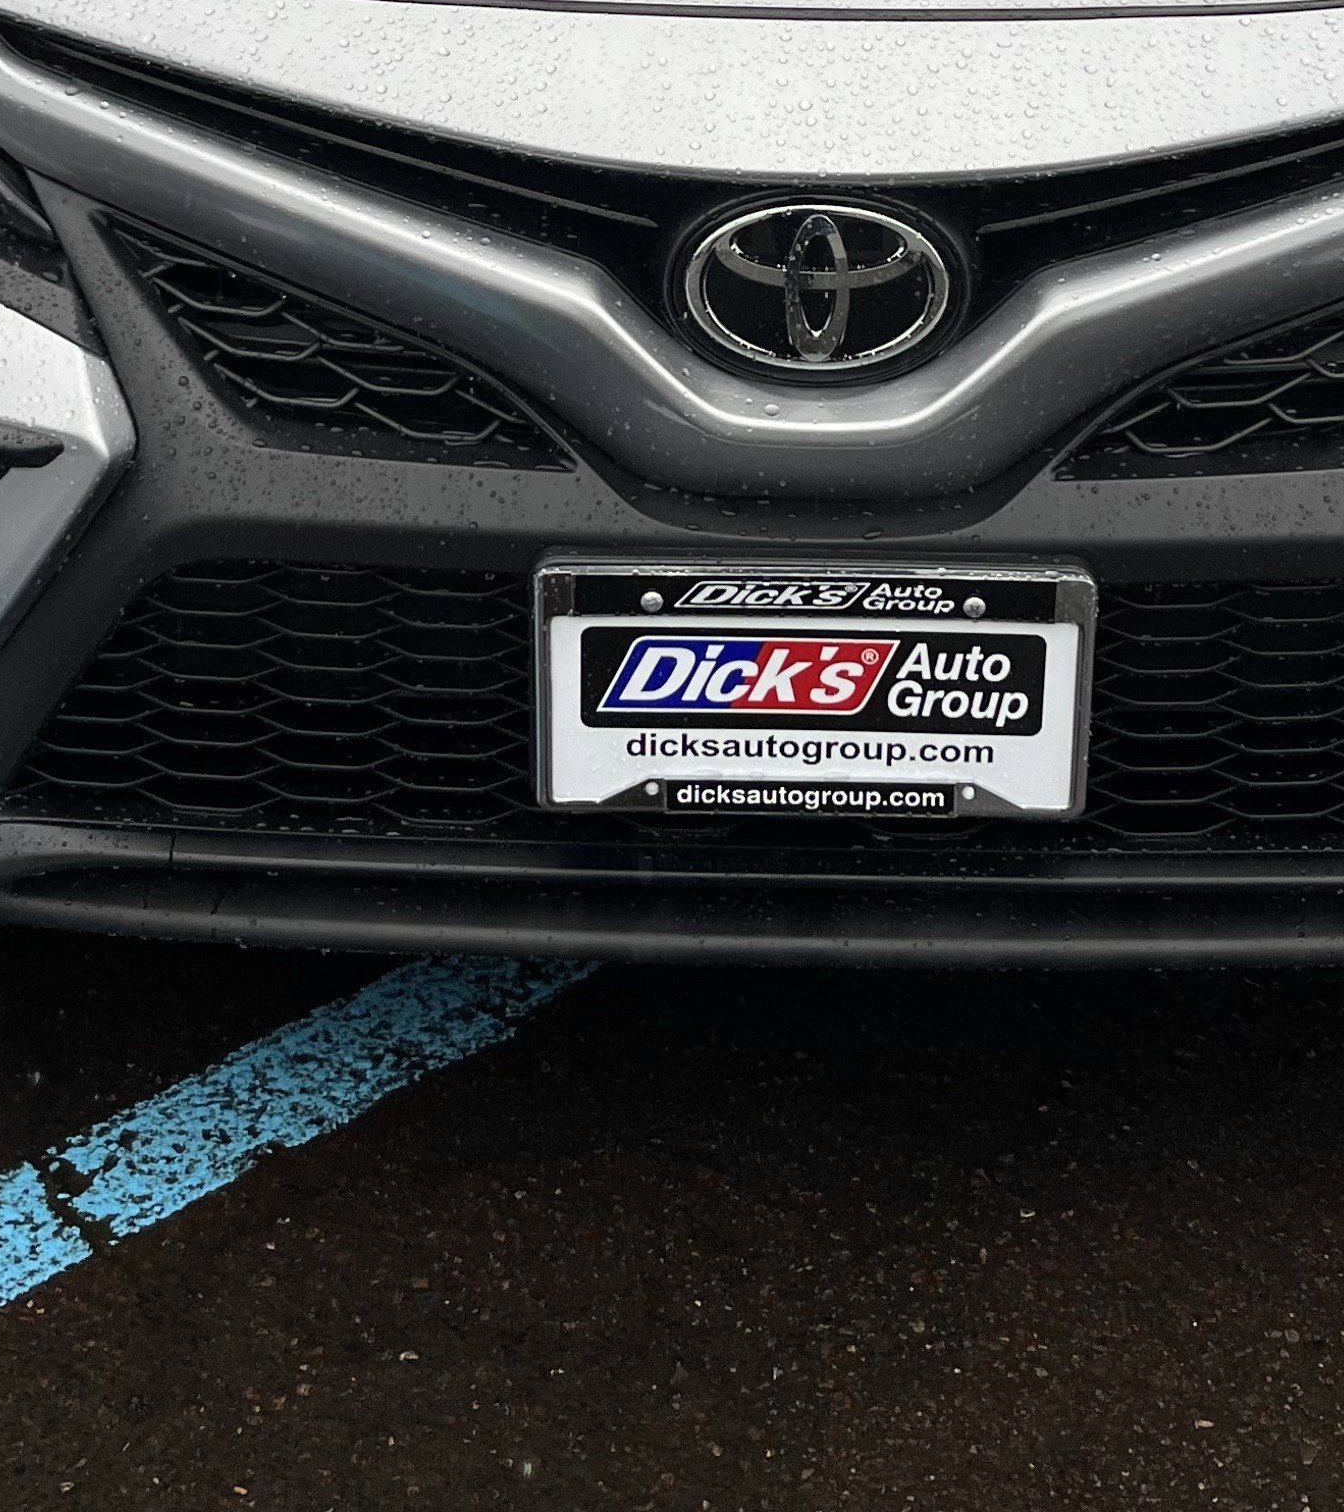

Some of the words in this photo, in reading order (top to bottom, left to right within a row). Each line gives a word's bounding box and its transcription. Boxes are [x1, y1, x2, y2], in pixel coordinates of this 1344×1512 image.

[689, 583, 849, 606] Dick's
[862, 596, 955, 614] Group
[869, 582, 943, 599] Auto
[618, 643, 865, 704] Dick's
[895, 642, 1011, 683] Auto
[886, 679, 1029, 727] Group
[626, 732, 994, 767] dicksautogroup.com
[676, 785, 945, 810] dicksautogroup.com
